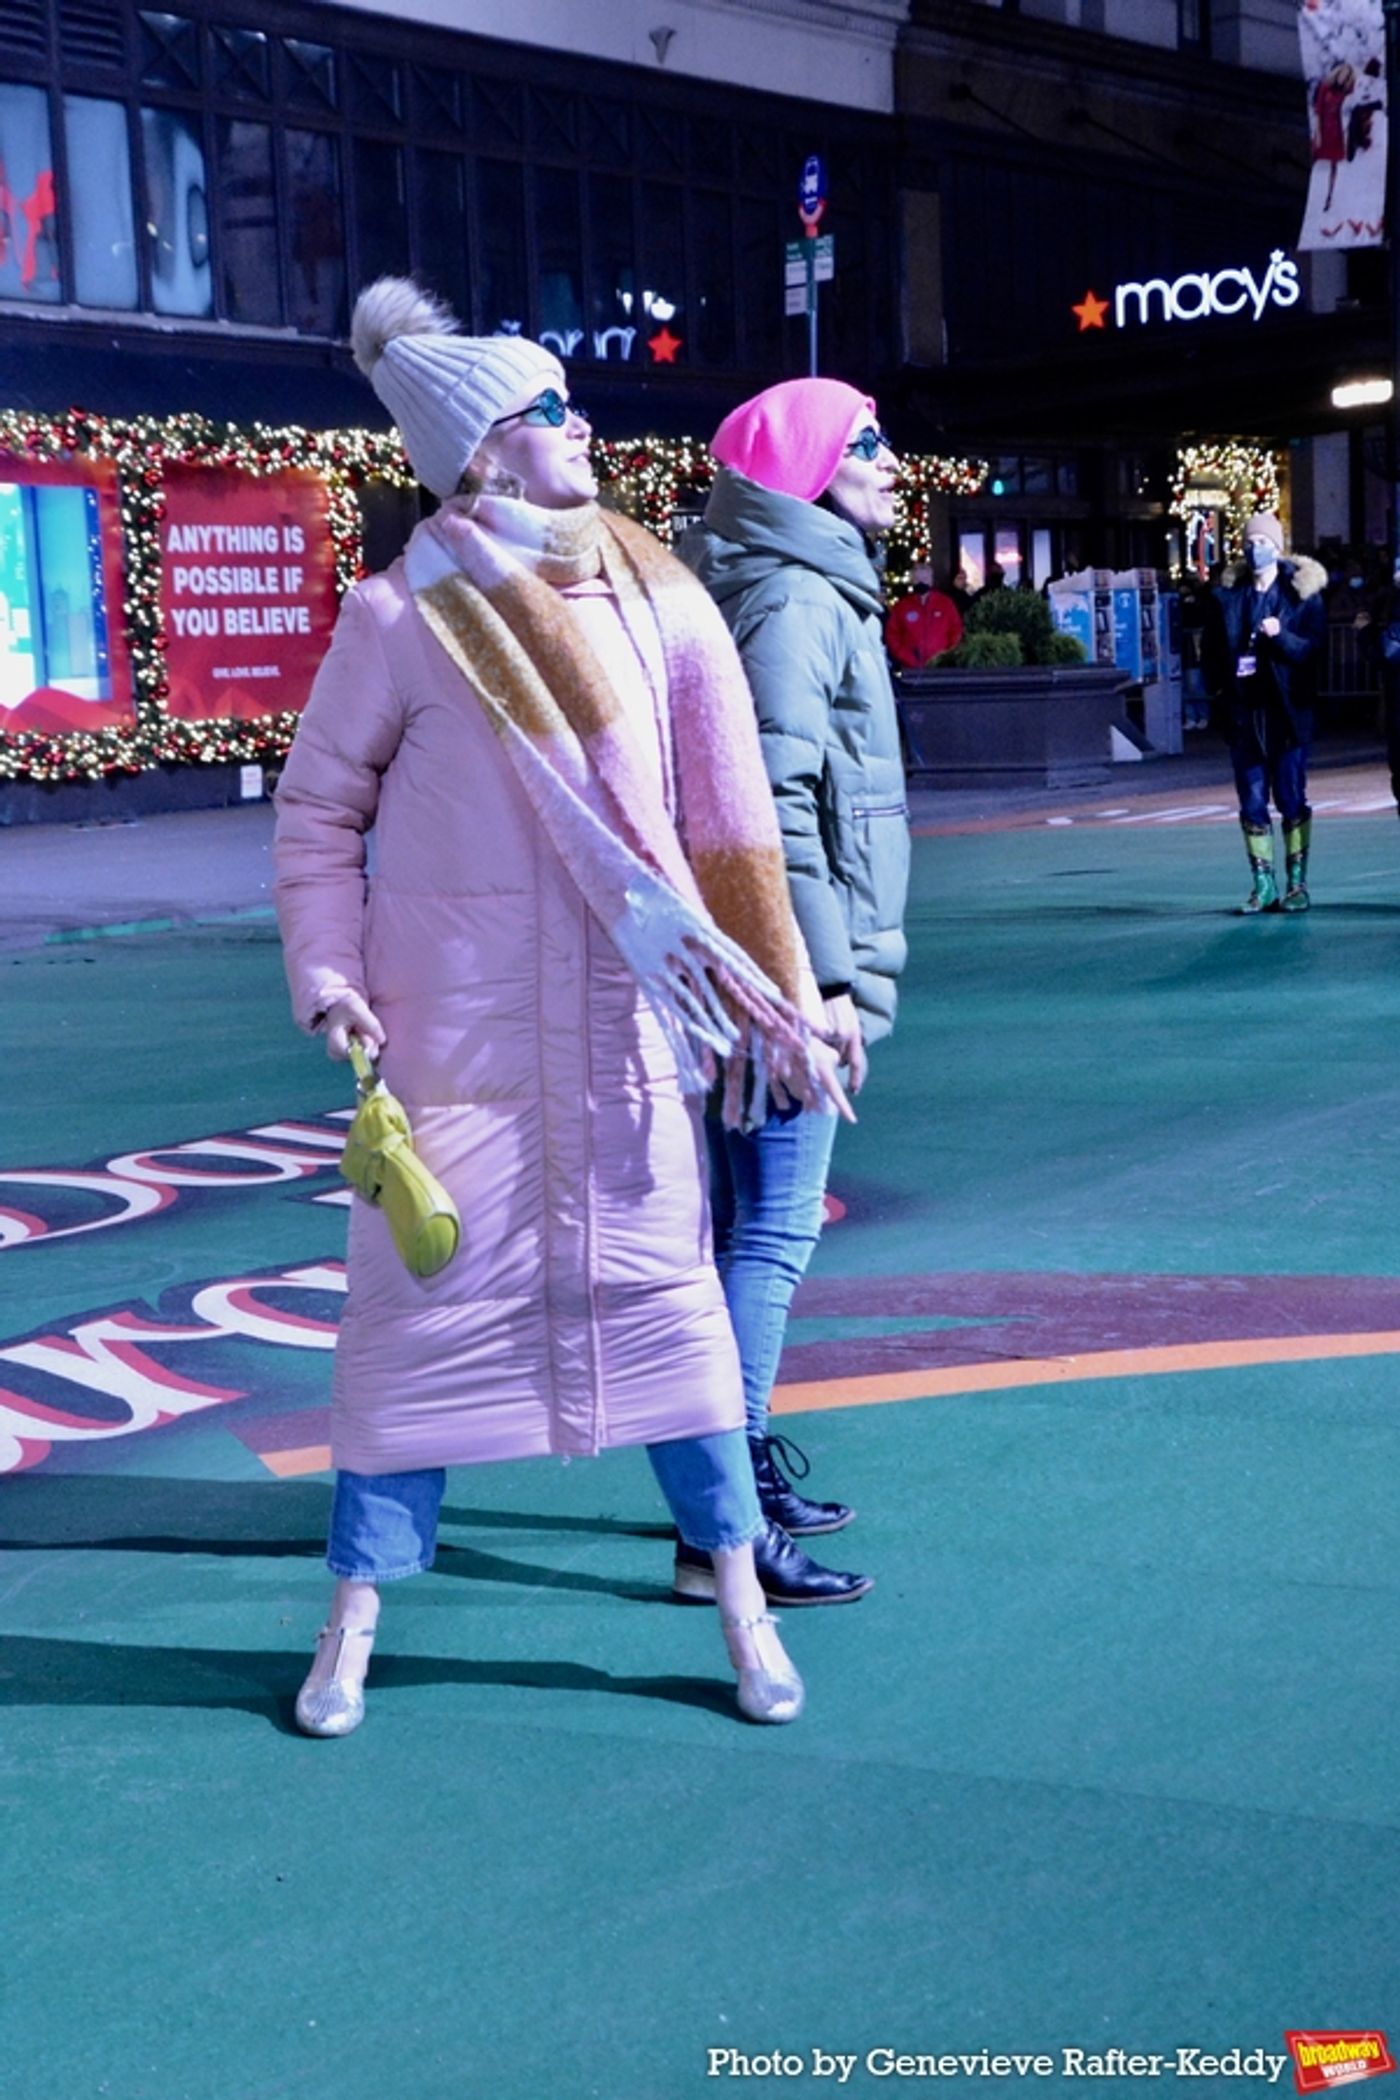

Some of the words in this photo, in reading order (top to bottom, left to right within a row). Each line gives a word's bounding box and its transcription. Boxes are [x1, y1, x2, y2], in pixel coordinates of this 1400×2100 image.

[1115, 248, 1300, 328] macy's
[167, 524, 280, 553] ANYTHING
[283, 525, 306, 553] IS
[172, 565, 279, 595] POSSIBLE
[283, 566, 304, 593] IF
[170, 607, 219, 637] YOU
[223, 606, 311, 635] BELIEVE
